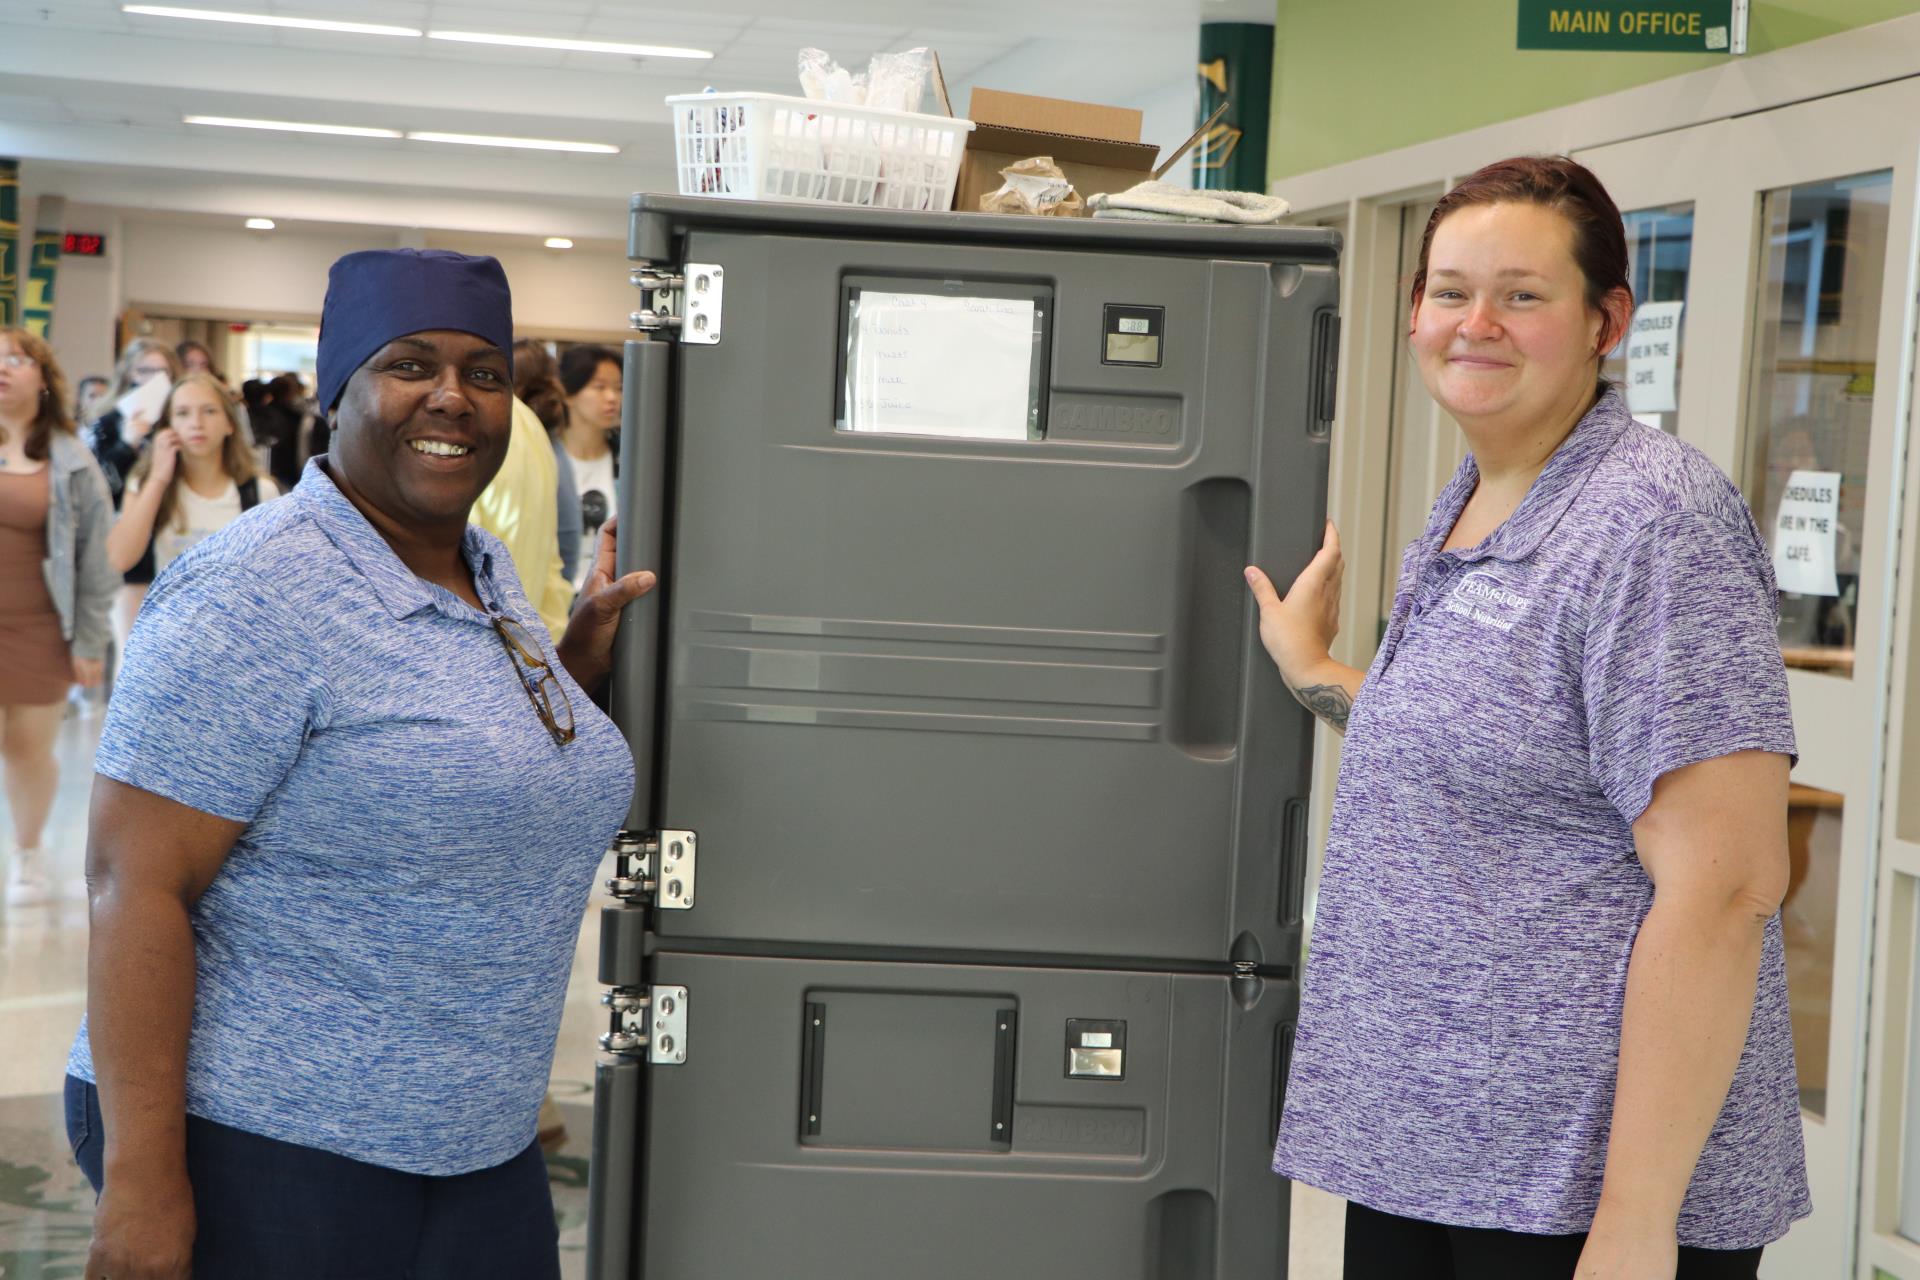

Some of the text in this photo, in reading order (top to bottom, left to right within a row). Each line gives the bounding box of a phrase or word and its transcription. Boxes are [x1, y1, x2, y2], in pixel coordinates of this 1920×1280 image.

[1550, 10, 1701, 35] MAIN OFFICE
[1654, 343, 1669, 357] THE
[1054, 402, 1173, 435] CAMBRO
[1783, 487, 1832, 503] CHEDULES
[1795, 516, 1807, 531] IN
[1809, 518, 1828, 533] THE
[1446, 600, 1472, 617] School
